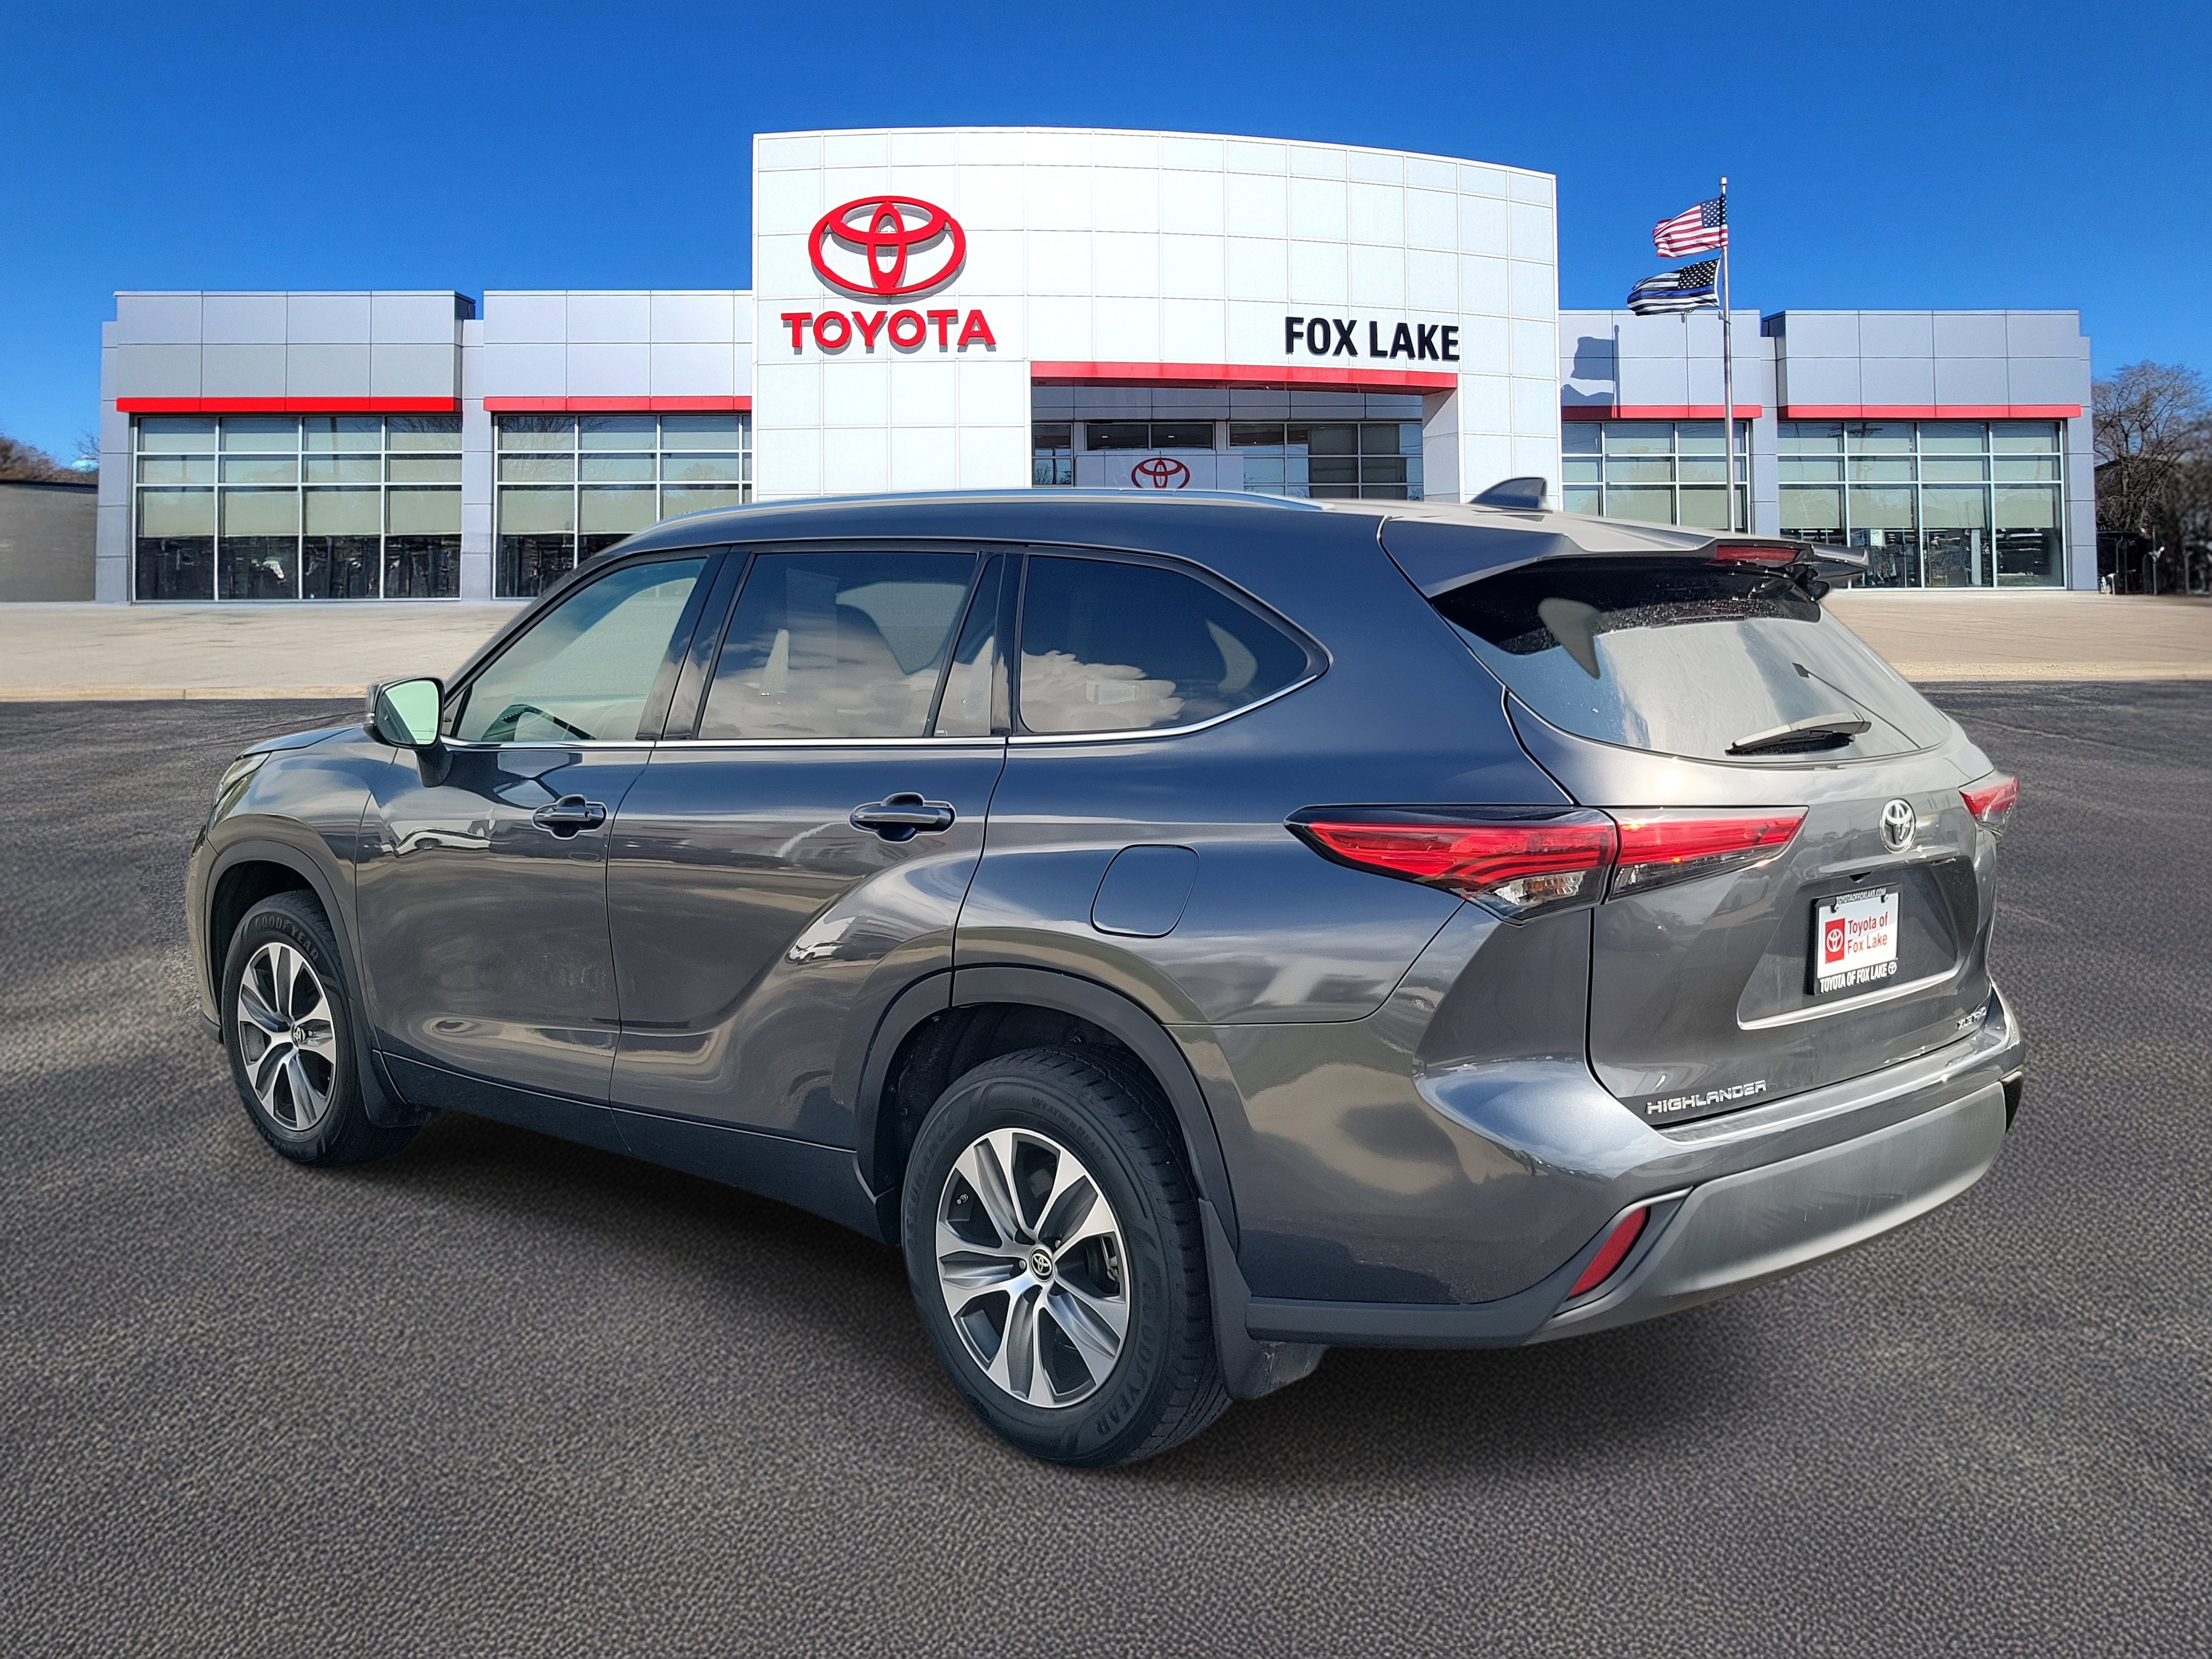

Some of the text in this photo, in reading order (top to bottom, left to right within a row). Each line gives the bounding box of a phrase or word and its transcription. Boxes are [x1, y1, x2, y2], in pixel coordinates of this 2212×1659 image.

[781, 309, 997, 352] TOYOTA
[1285, 317, 1460, 360] FOX LAKE
[1848, 911, 1889, 937] Toyota of
[1848, 933, 1888, 955] Fox Lake
[1820, 963, 1888, 993] TOYOTA OF FOX LAKE
[1647, 1080, 1767, 1114] HIGHLANDER
